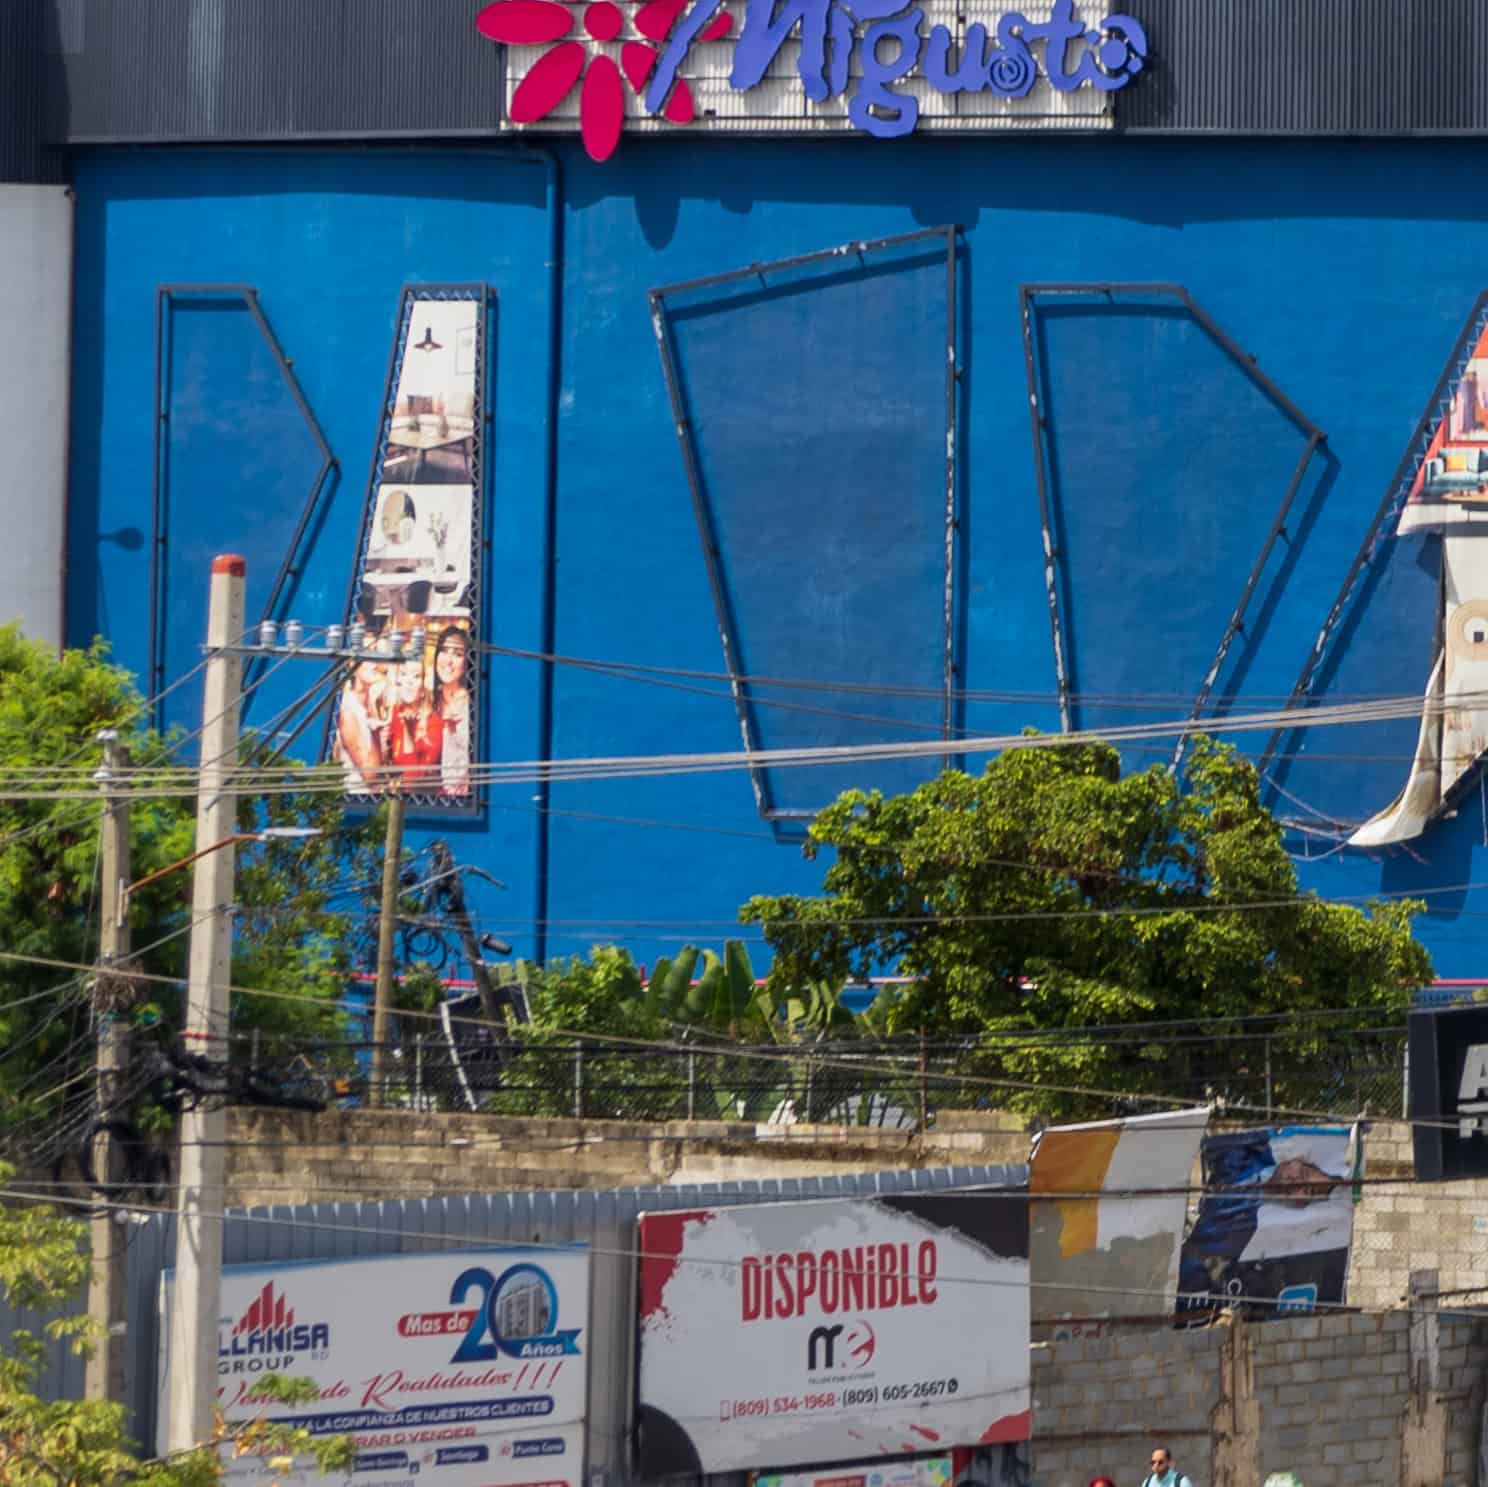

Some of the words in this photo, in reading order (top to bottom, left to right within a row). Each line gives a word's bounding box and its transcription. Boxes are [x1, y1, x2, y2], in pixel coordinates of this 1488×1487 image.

[404, 1314, 442, 1335] Mas
[447, 1311, 470, 1331] de
[521, 1340, 563, 1357] Años
[217, 1355, 295, 1375] GROUP
[842, 1386, 879, 1409] (809)
